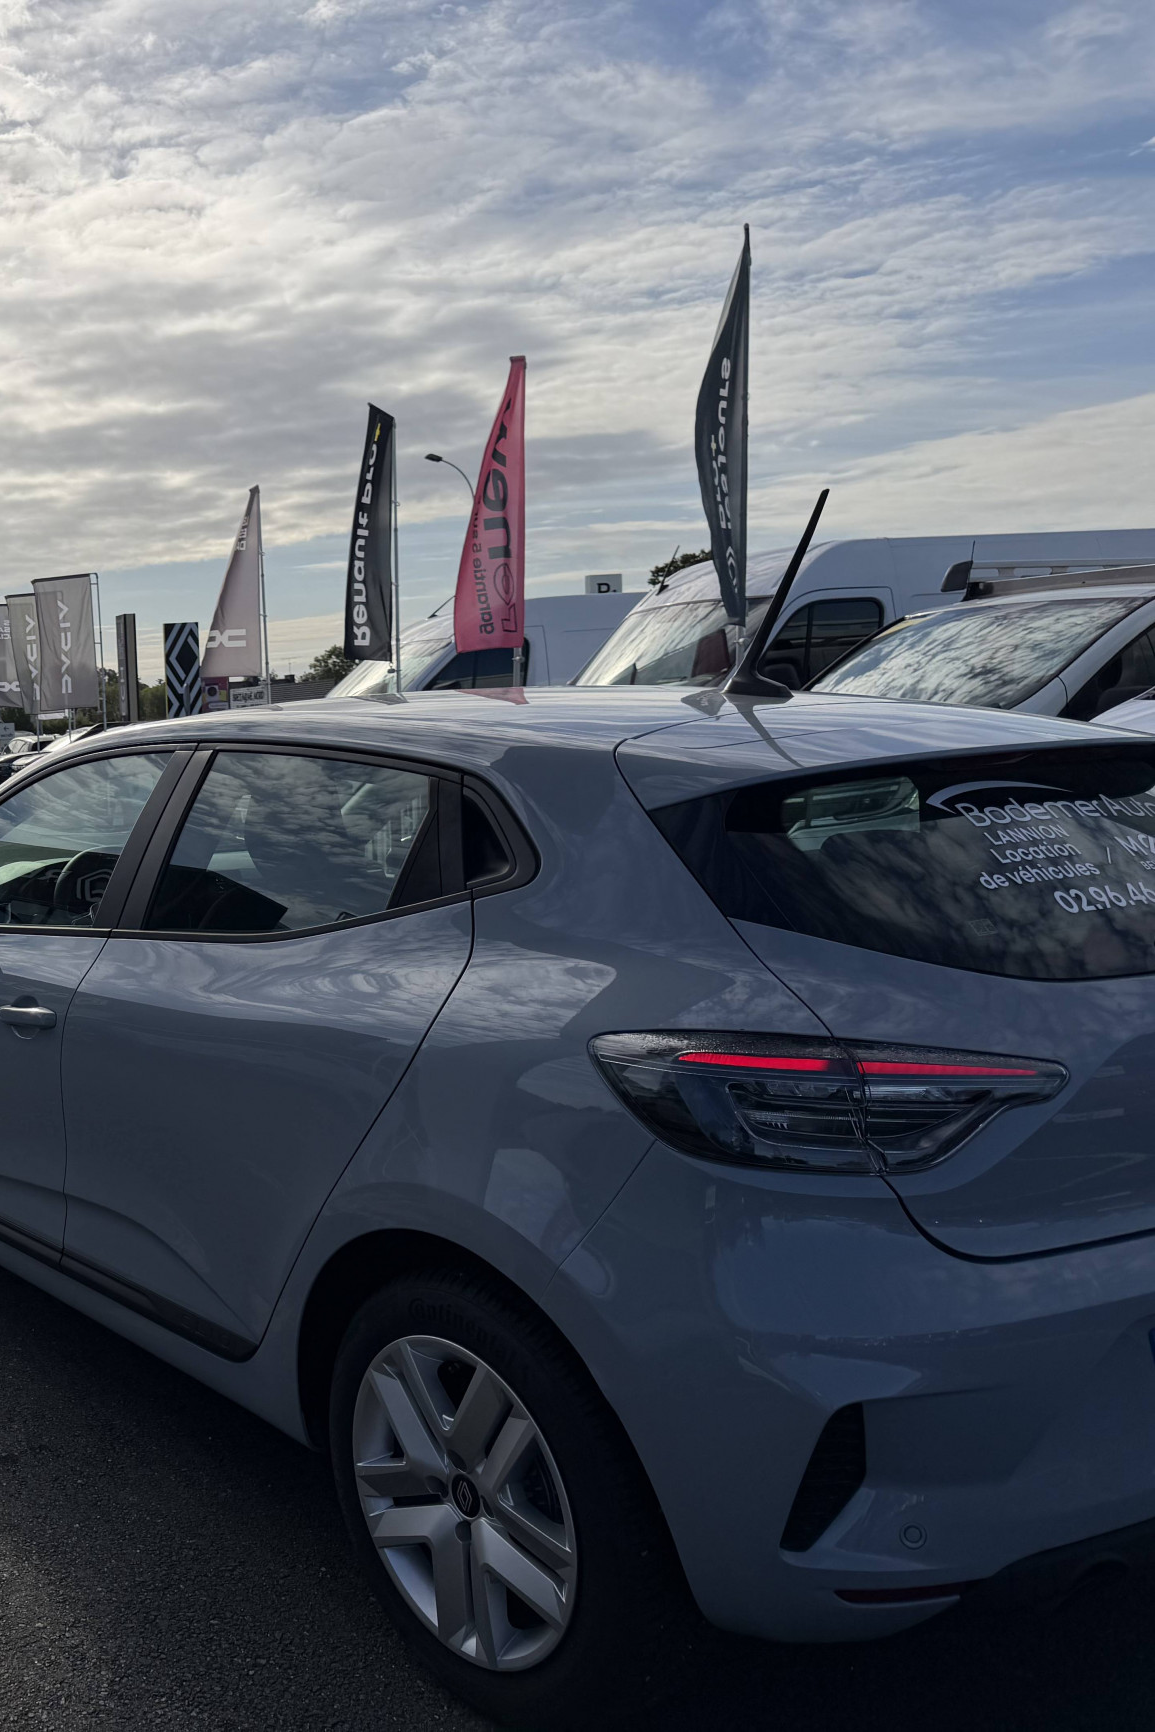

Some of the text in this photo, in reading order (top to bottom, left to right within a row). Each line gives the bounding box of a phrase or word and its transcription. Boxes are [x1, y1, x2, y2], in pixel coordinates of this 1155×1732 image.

[983, 824, 1070, 846] LANNION
[990, 843, 1082, 864] Location
[979, 861, 1101, 890] de véhicules
